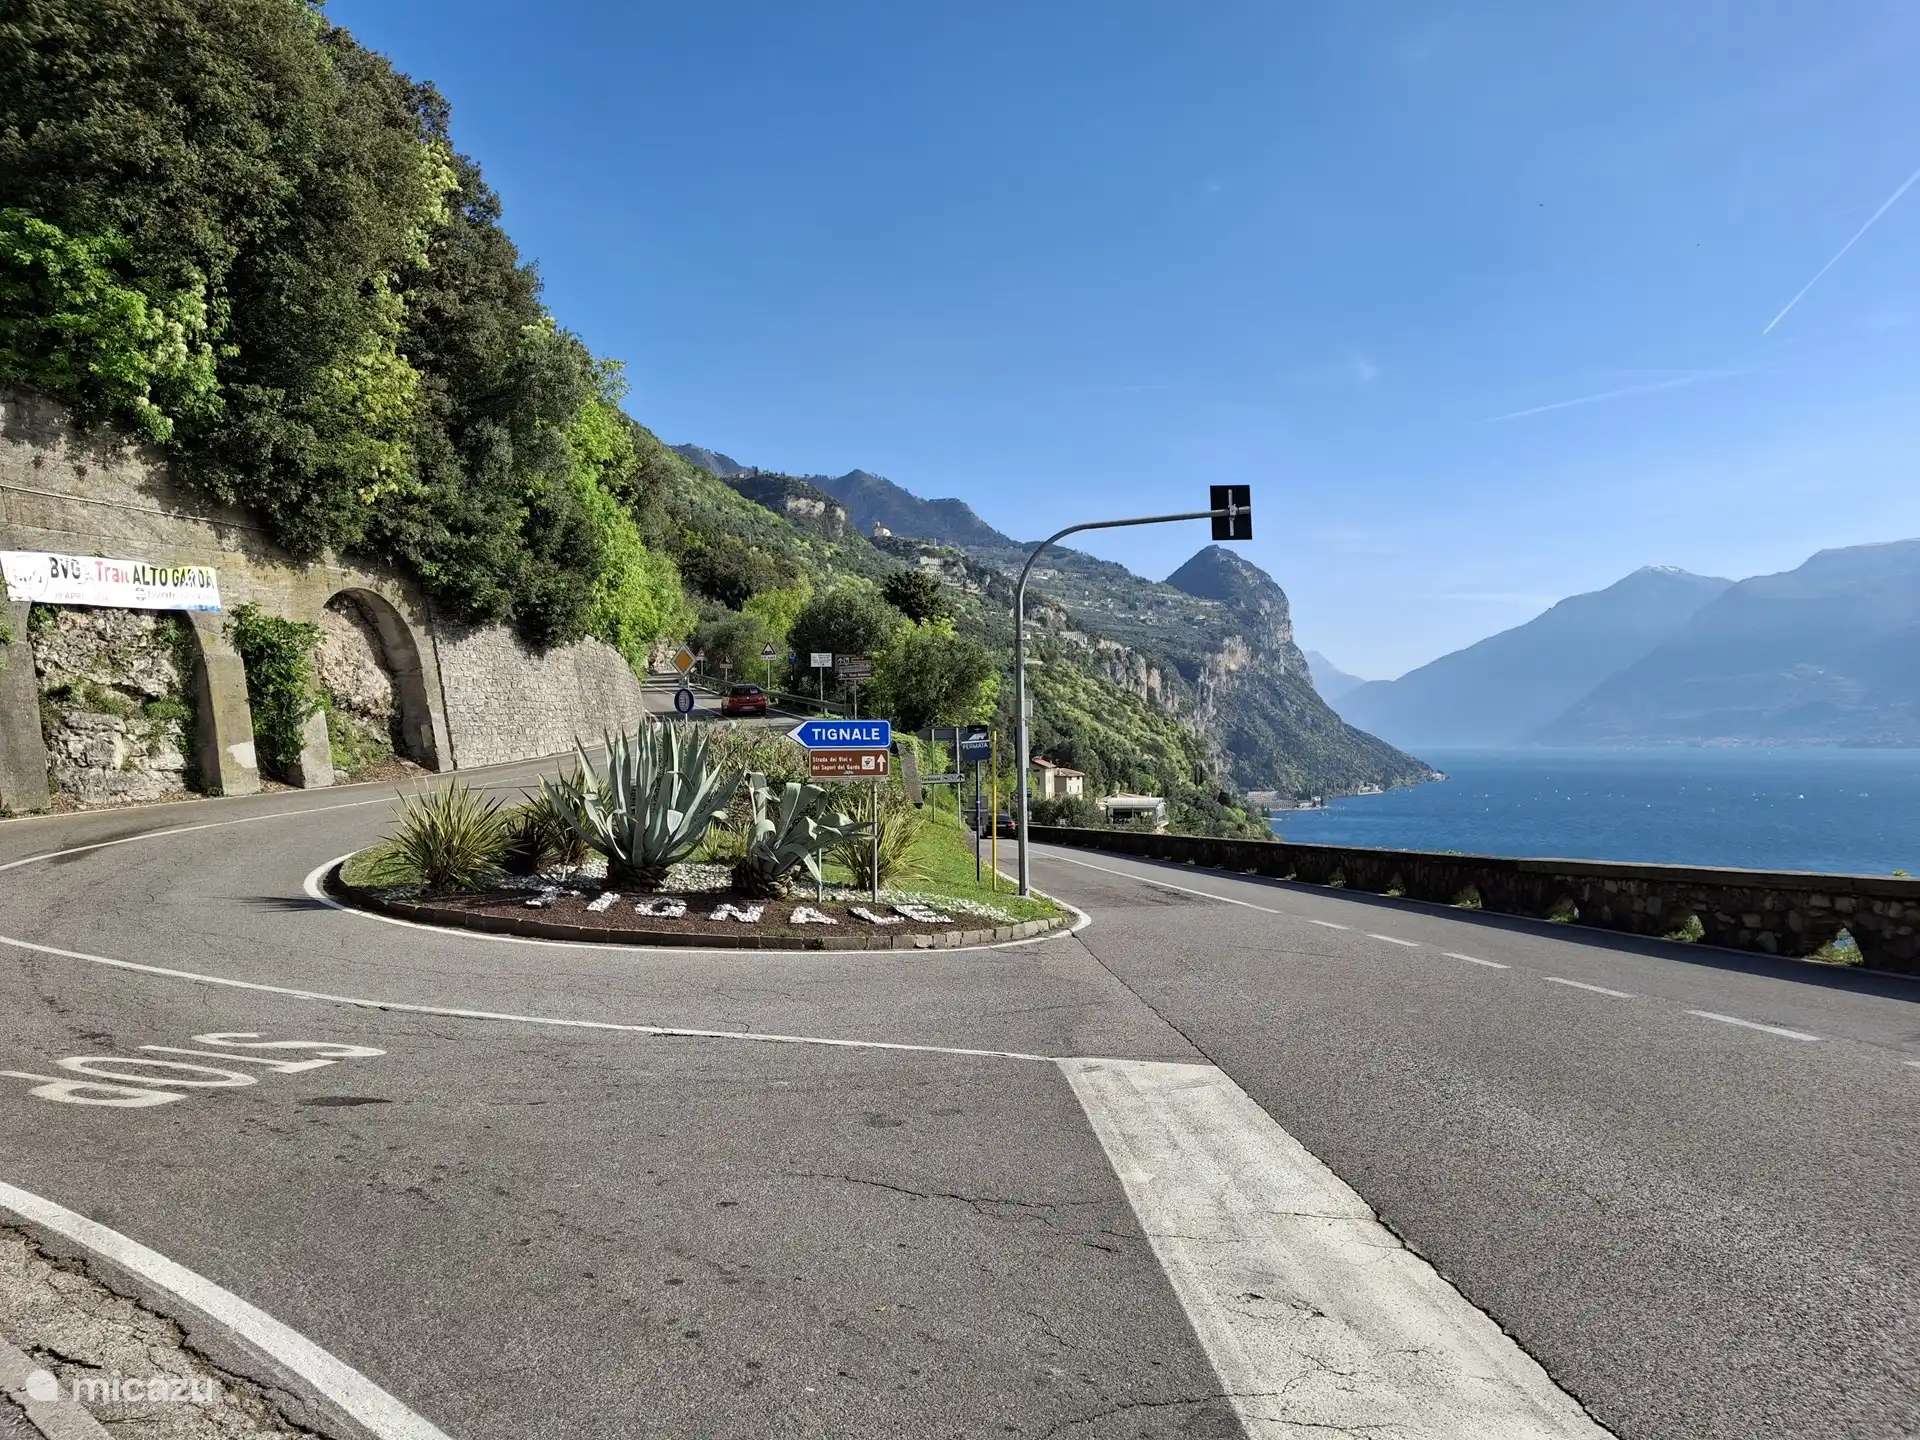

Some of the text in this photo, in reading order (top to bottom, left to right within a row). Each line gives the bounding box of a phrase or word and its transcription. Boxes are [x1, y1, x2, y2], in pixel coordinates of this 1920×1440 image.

[49, 556, 81, 581] BVG
[94, 561, 130, 584] Trail
[133, 565, 168, 587] ALTO
[811, 728, 880, 740] TIGNALE
[525, 886, 955, 925] TIGNALE
